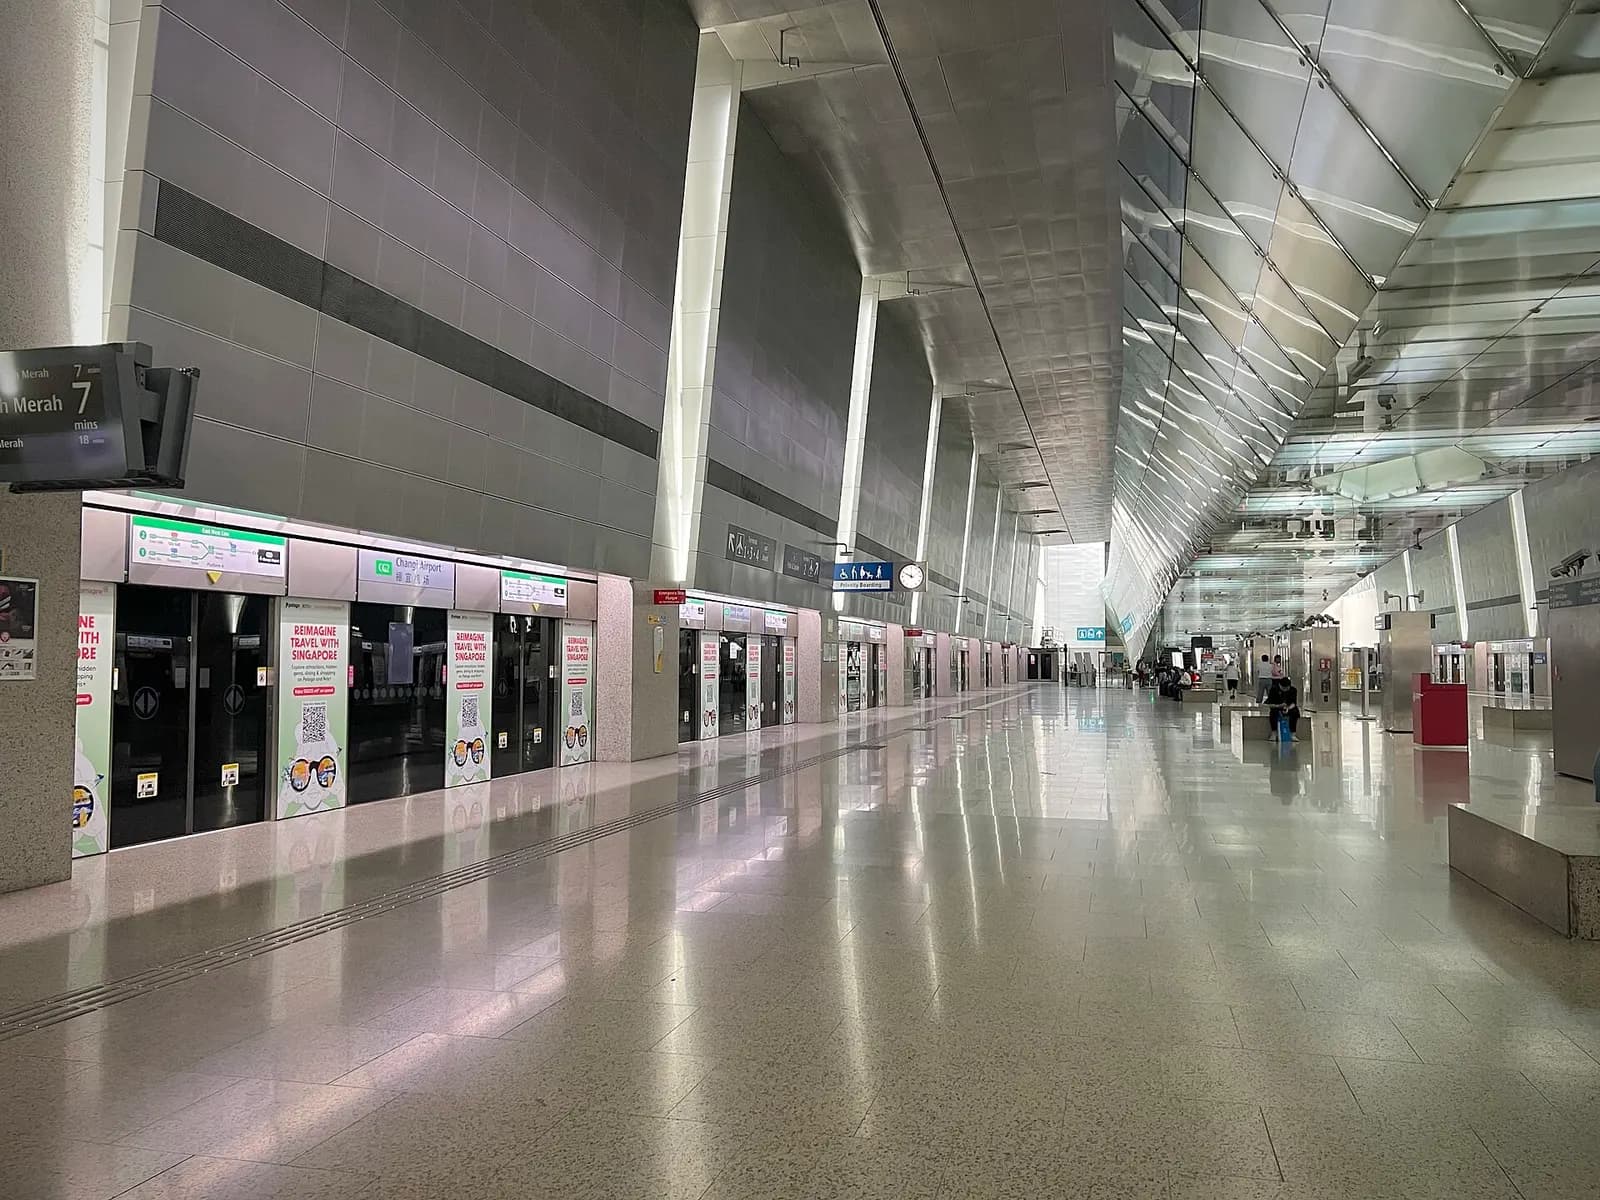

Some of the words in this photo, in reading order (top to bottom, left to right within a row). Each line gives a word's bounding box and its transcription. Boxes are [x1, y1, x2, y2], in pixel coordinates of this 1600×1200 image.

[22, 368, 49, 379] Merah
[73, 364, 82, 378] 7
[14, 394, 63, 413] Merah
[72, 381, 92, 414] 7
[74, 419, 98, 430] mins
[79, 435, 90, 445] 18
[396, 557, 419, 571] Changi
[420, 560, 442, 573] Airport
[294, 625, 337, 636] REIMAGINE
[456, 632, 485, 642] REIMAGINE
[290, 637, 319, 649] TRAVEL
[320, 639, 340, 649] WITH
[454, 642, 473, 651] TRAVEL
[473, 643, 487, 651] WITH
[292, 649, 338, 661] SINGAPORE
[455, 652, 486, 661] SINGAPORE
